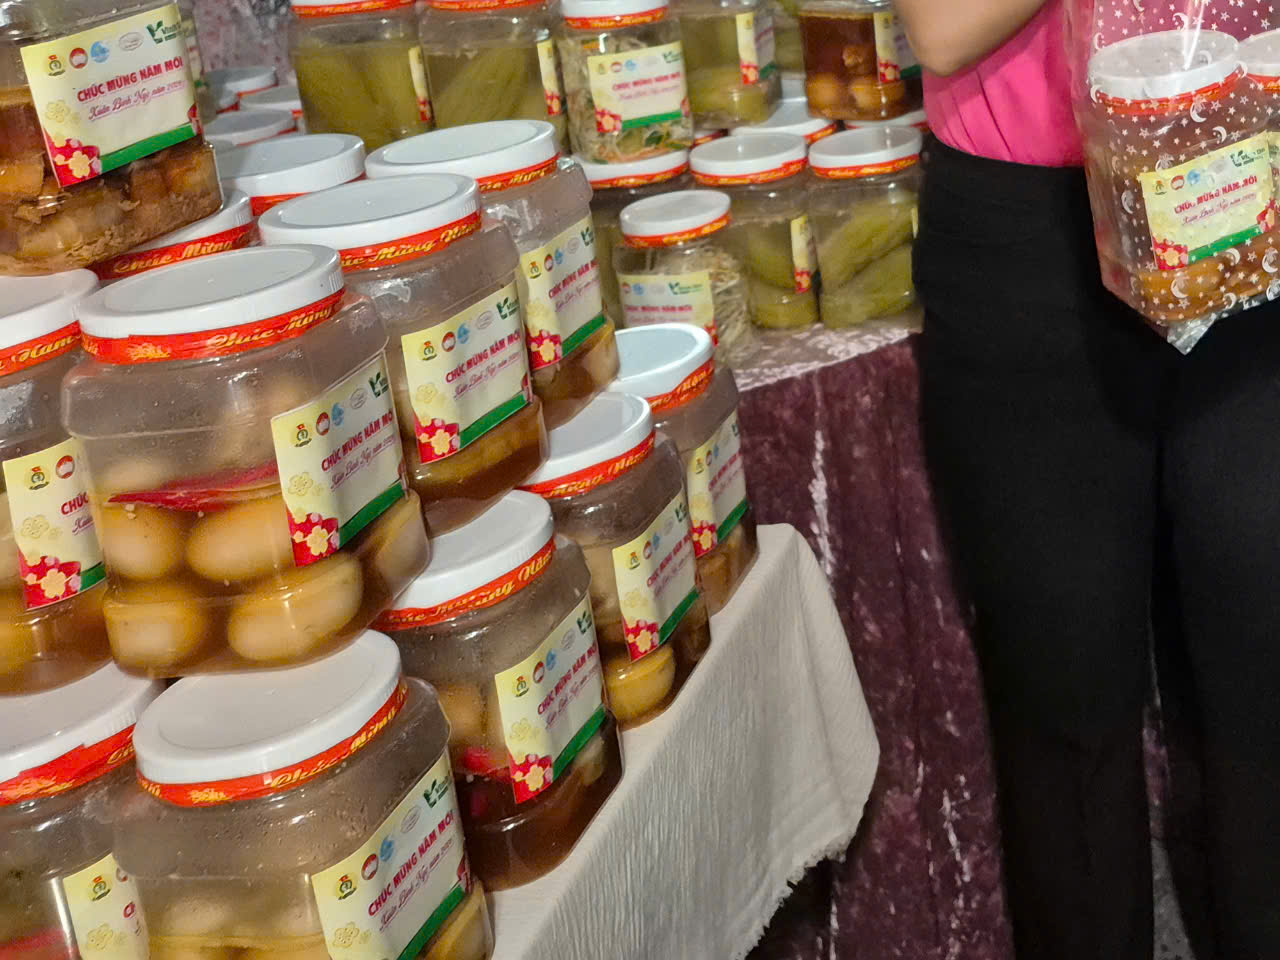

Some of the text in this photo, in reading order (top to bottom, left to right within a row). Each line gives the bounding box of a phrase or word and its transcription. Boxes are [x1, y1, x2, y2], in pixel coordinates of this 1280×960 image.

[77, 83, 105, 102] CHÚC
[106, 72, 137, 92] MỪNG
[139, 63, 162, 81] NĂM
[368, 882, 393, 917] CHÚC
[393, 852, 418, 889] MỪNG
[418, 828, 437, 858] NĂM
